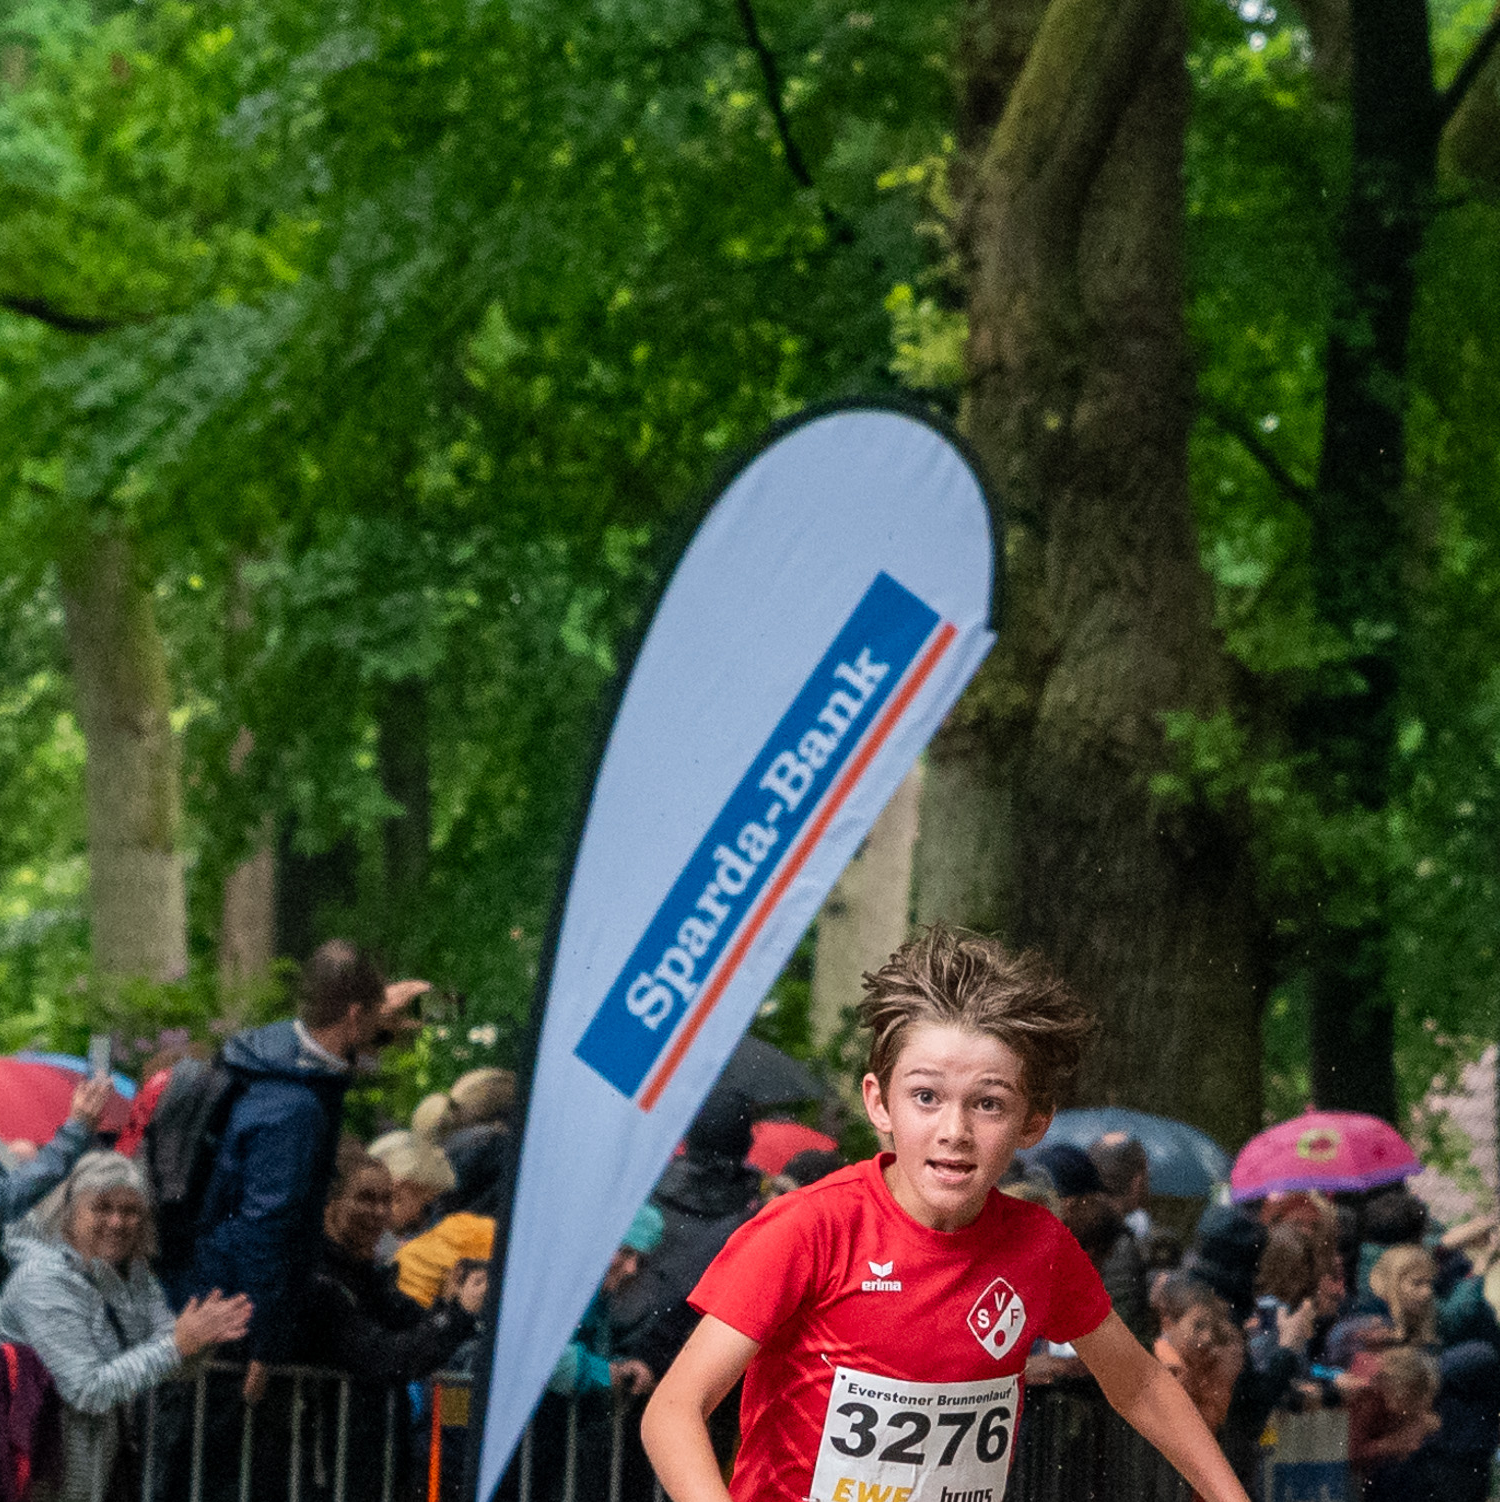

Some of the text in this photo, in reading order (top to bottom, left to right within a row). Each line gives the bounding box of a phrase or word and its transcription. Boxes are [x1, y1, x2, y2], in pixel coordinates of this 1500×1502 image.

[625, 644, 891, 1032] Sparda-Bank
[861, 1279, 902, 1292] erima
[847, 1382, 1012, 1406] Everstener Brunnenlauf
[830, 1402, 1011, 1466] 3276
